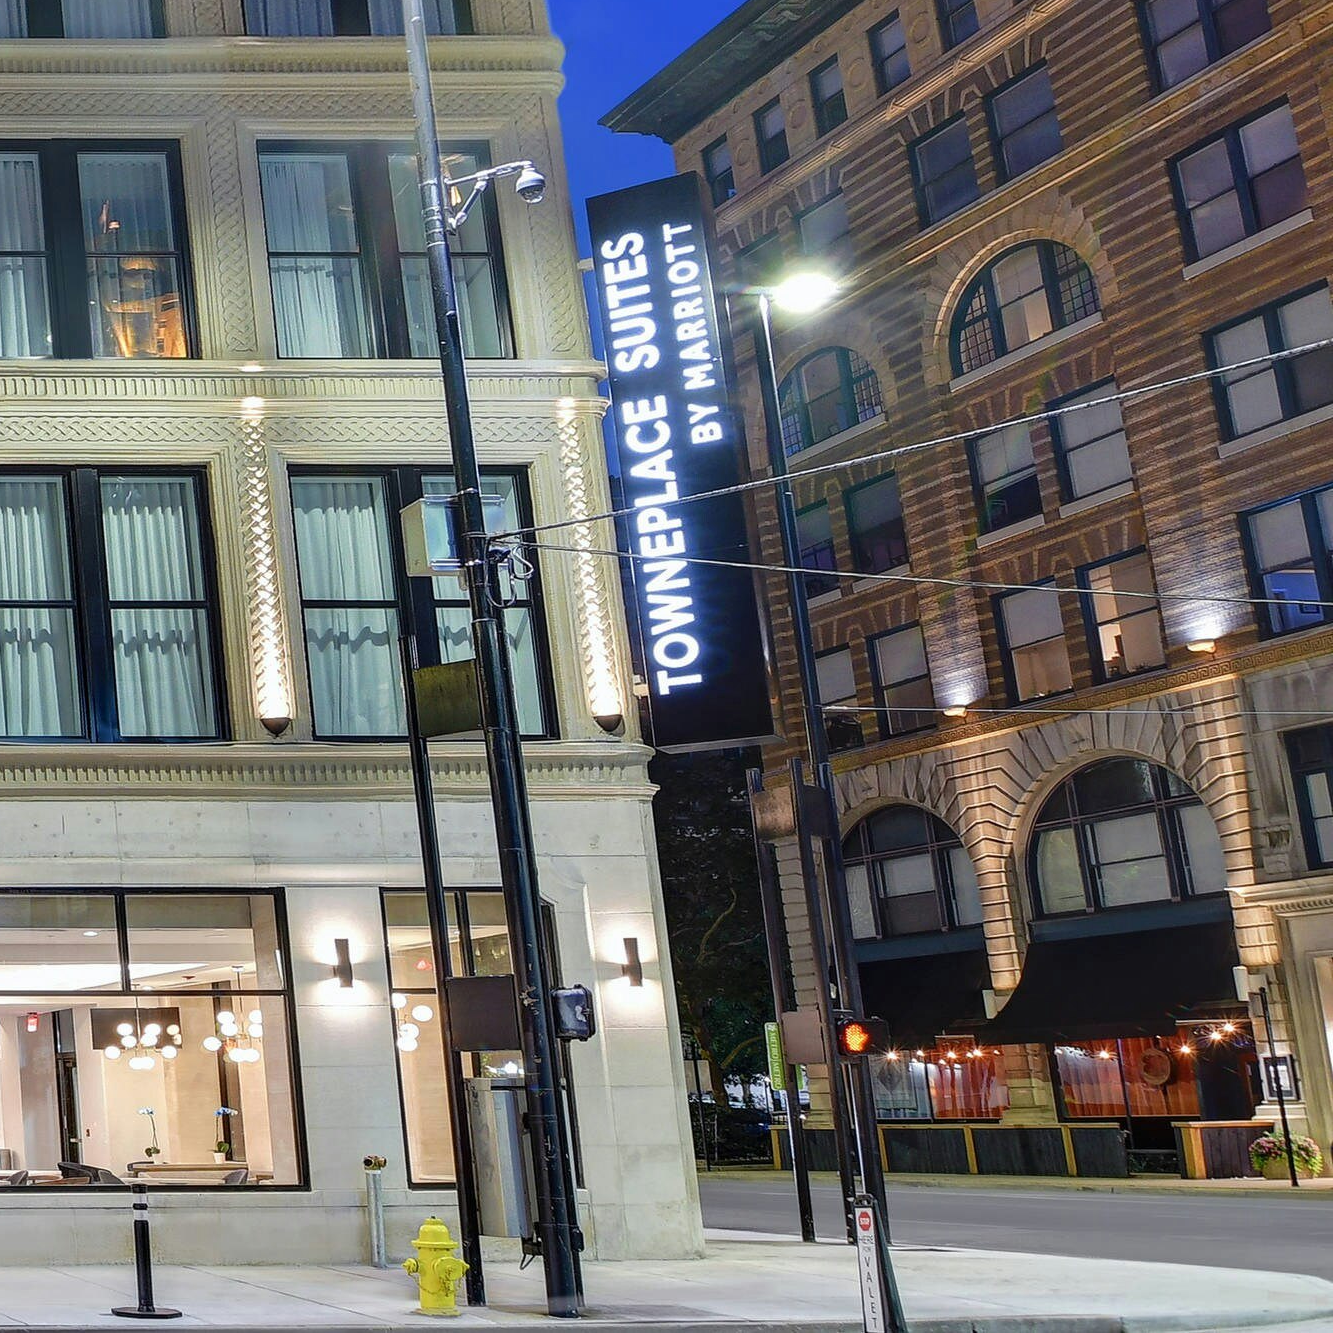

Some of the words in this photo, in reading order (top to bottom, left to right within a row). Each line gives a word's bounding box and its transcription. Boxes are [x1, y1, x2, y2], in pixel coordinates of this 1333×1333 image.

[601, 232, 661, 373] SUITES
[662, 223, 716, 391] MARRIOTT
[687, 403, 723, 444] BY
[621, 394, 703, 696] TOWNEPLACE
[769, 1031, 780, 1059] METRO
[772, 1061, 783, 1089] METRO
[864, 1256, 877, 1329] VALET
